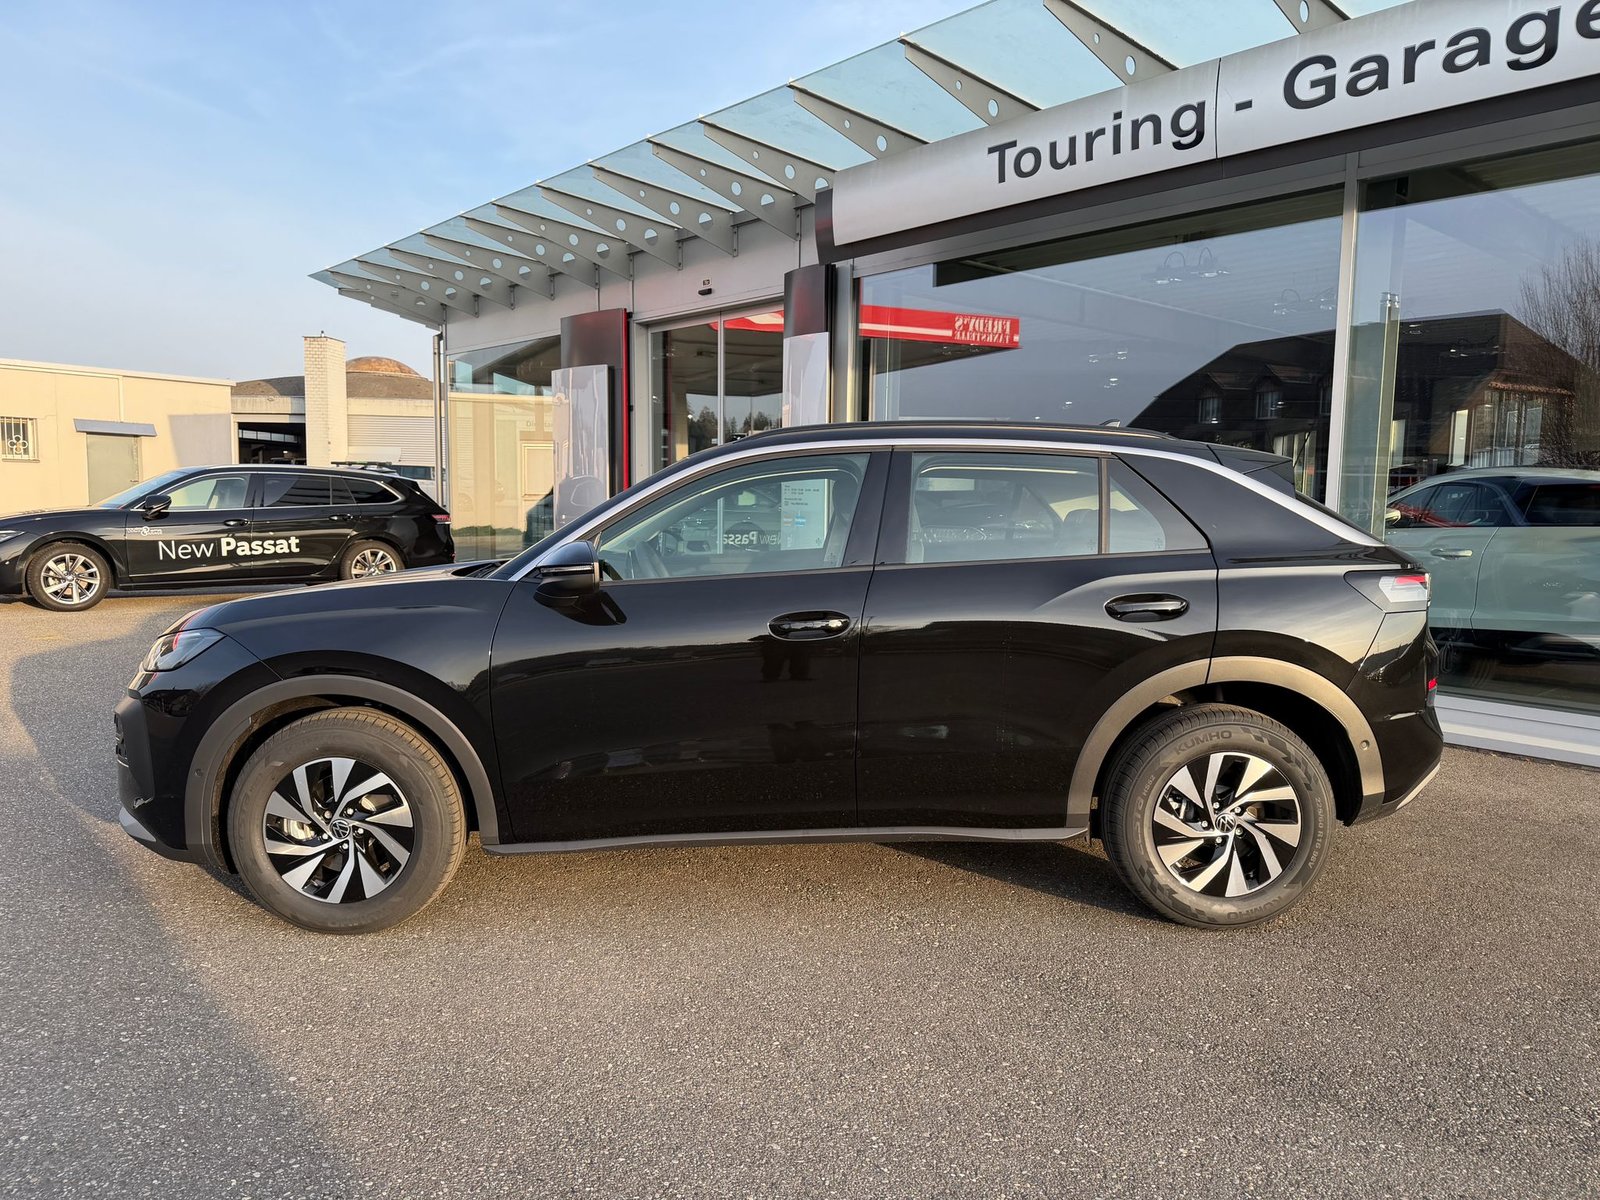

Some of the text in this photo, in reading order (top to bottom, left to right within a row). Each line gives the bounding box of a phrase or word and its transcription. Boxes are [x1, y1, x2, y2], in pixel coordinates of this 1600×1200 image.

[987, 99, 1206, 184] Touring
[158, 536, 300, 561] New Passat
[1174, 729, 1233, 756] KUMHO
